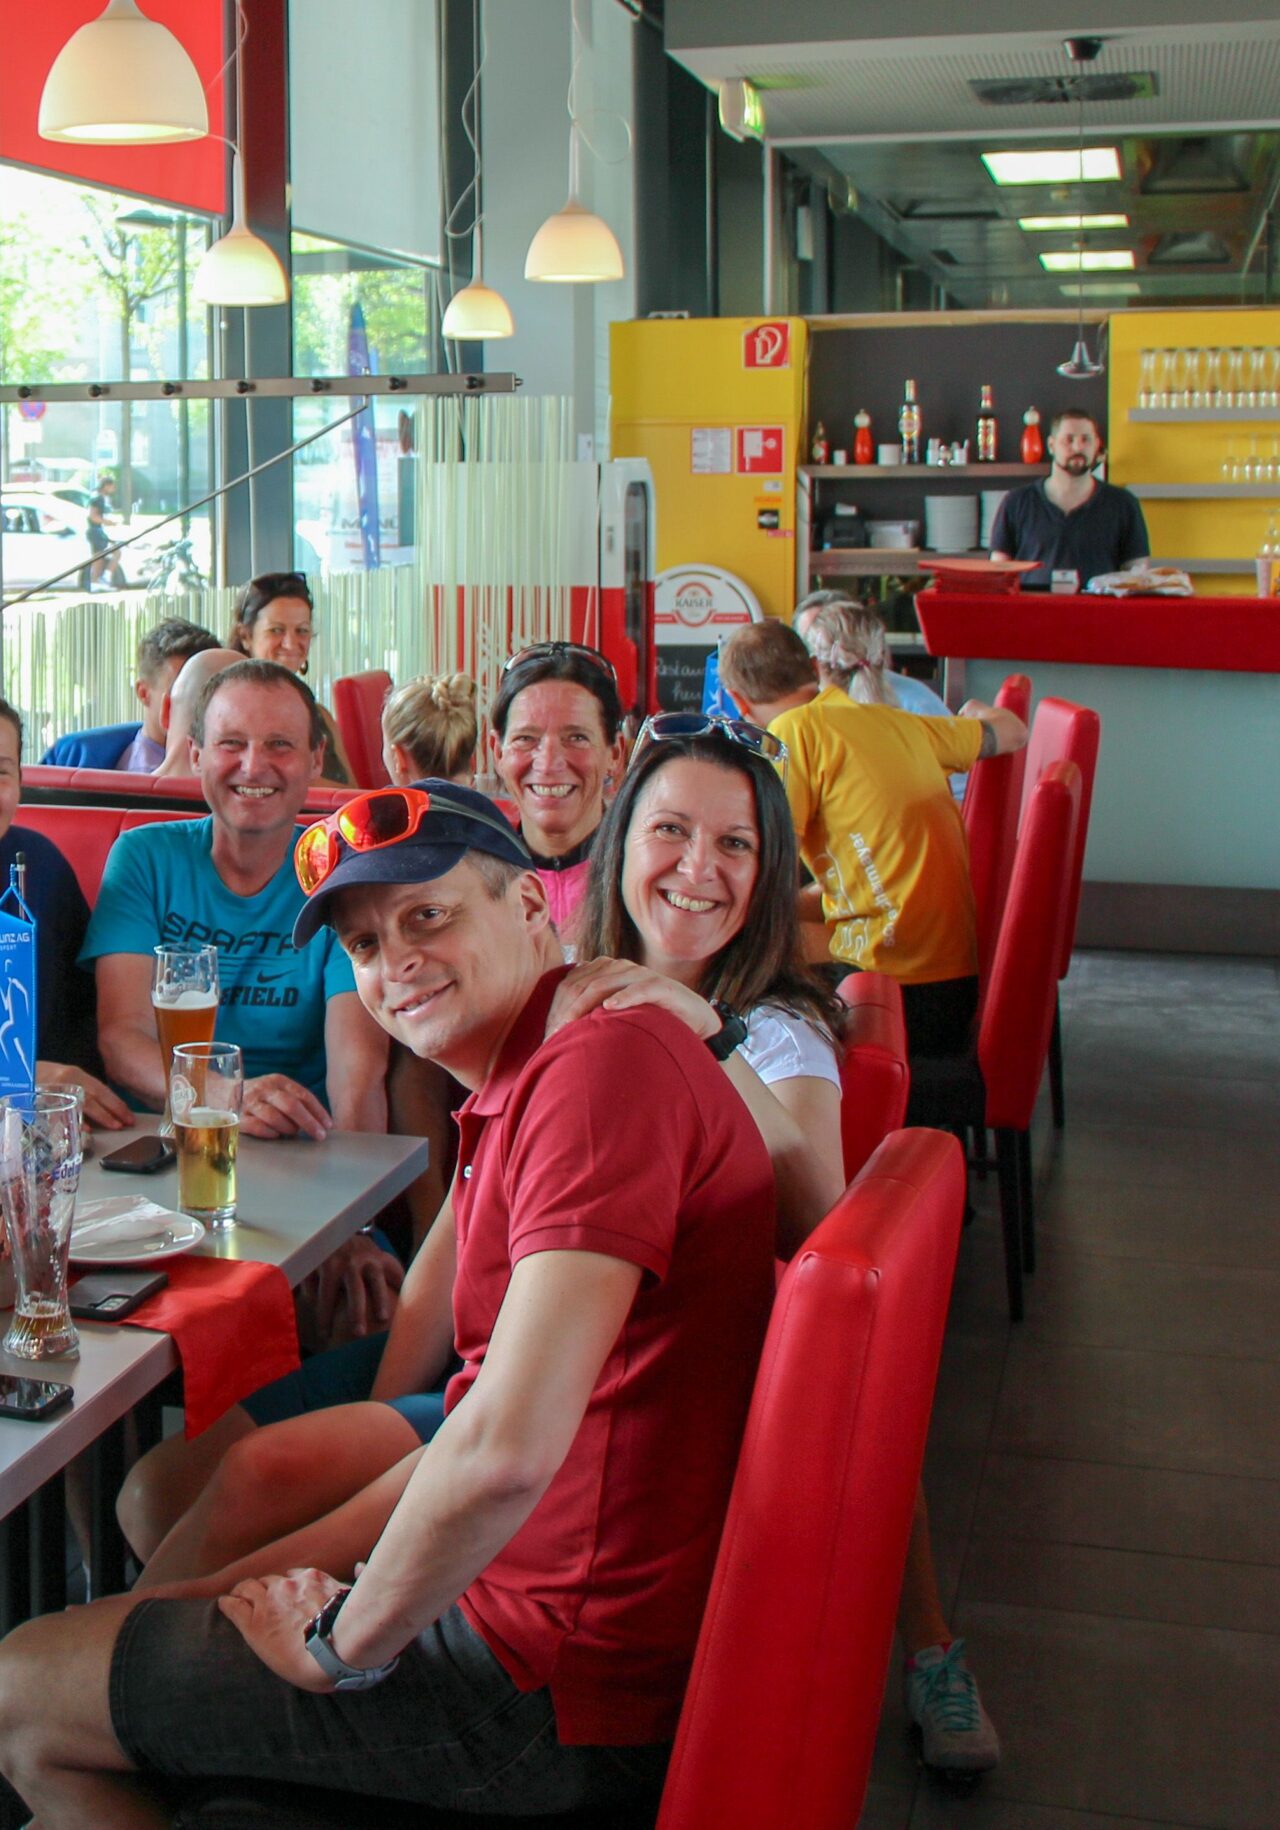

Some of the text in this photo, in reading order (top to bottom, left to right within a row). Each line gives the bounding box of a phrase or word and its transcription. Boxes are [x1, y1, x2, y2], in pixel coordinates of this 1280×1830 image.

[675, 599, 713, 608] KAISER
[0, 932, 30, 944] LINZ AG
